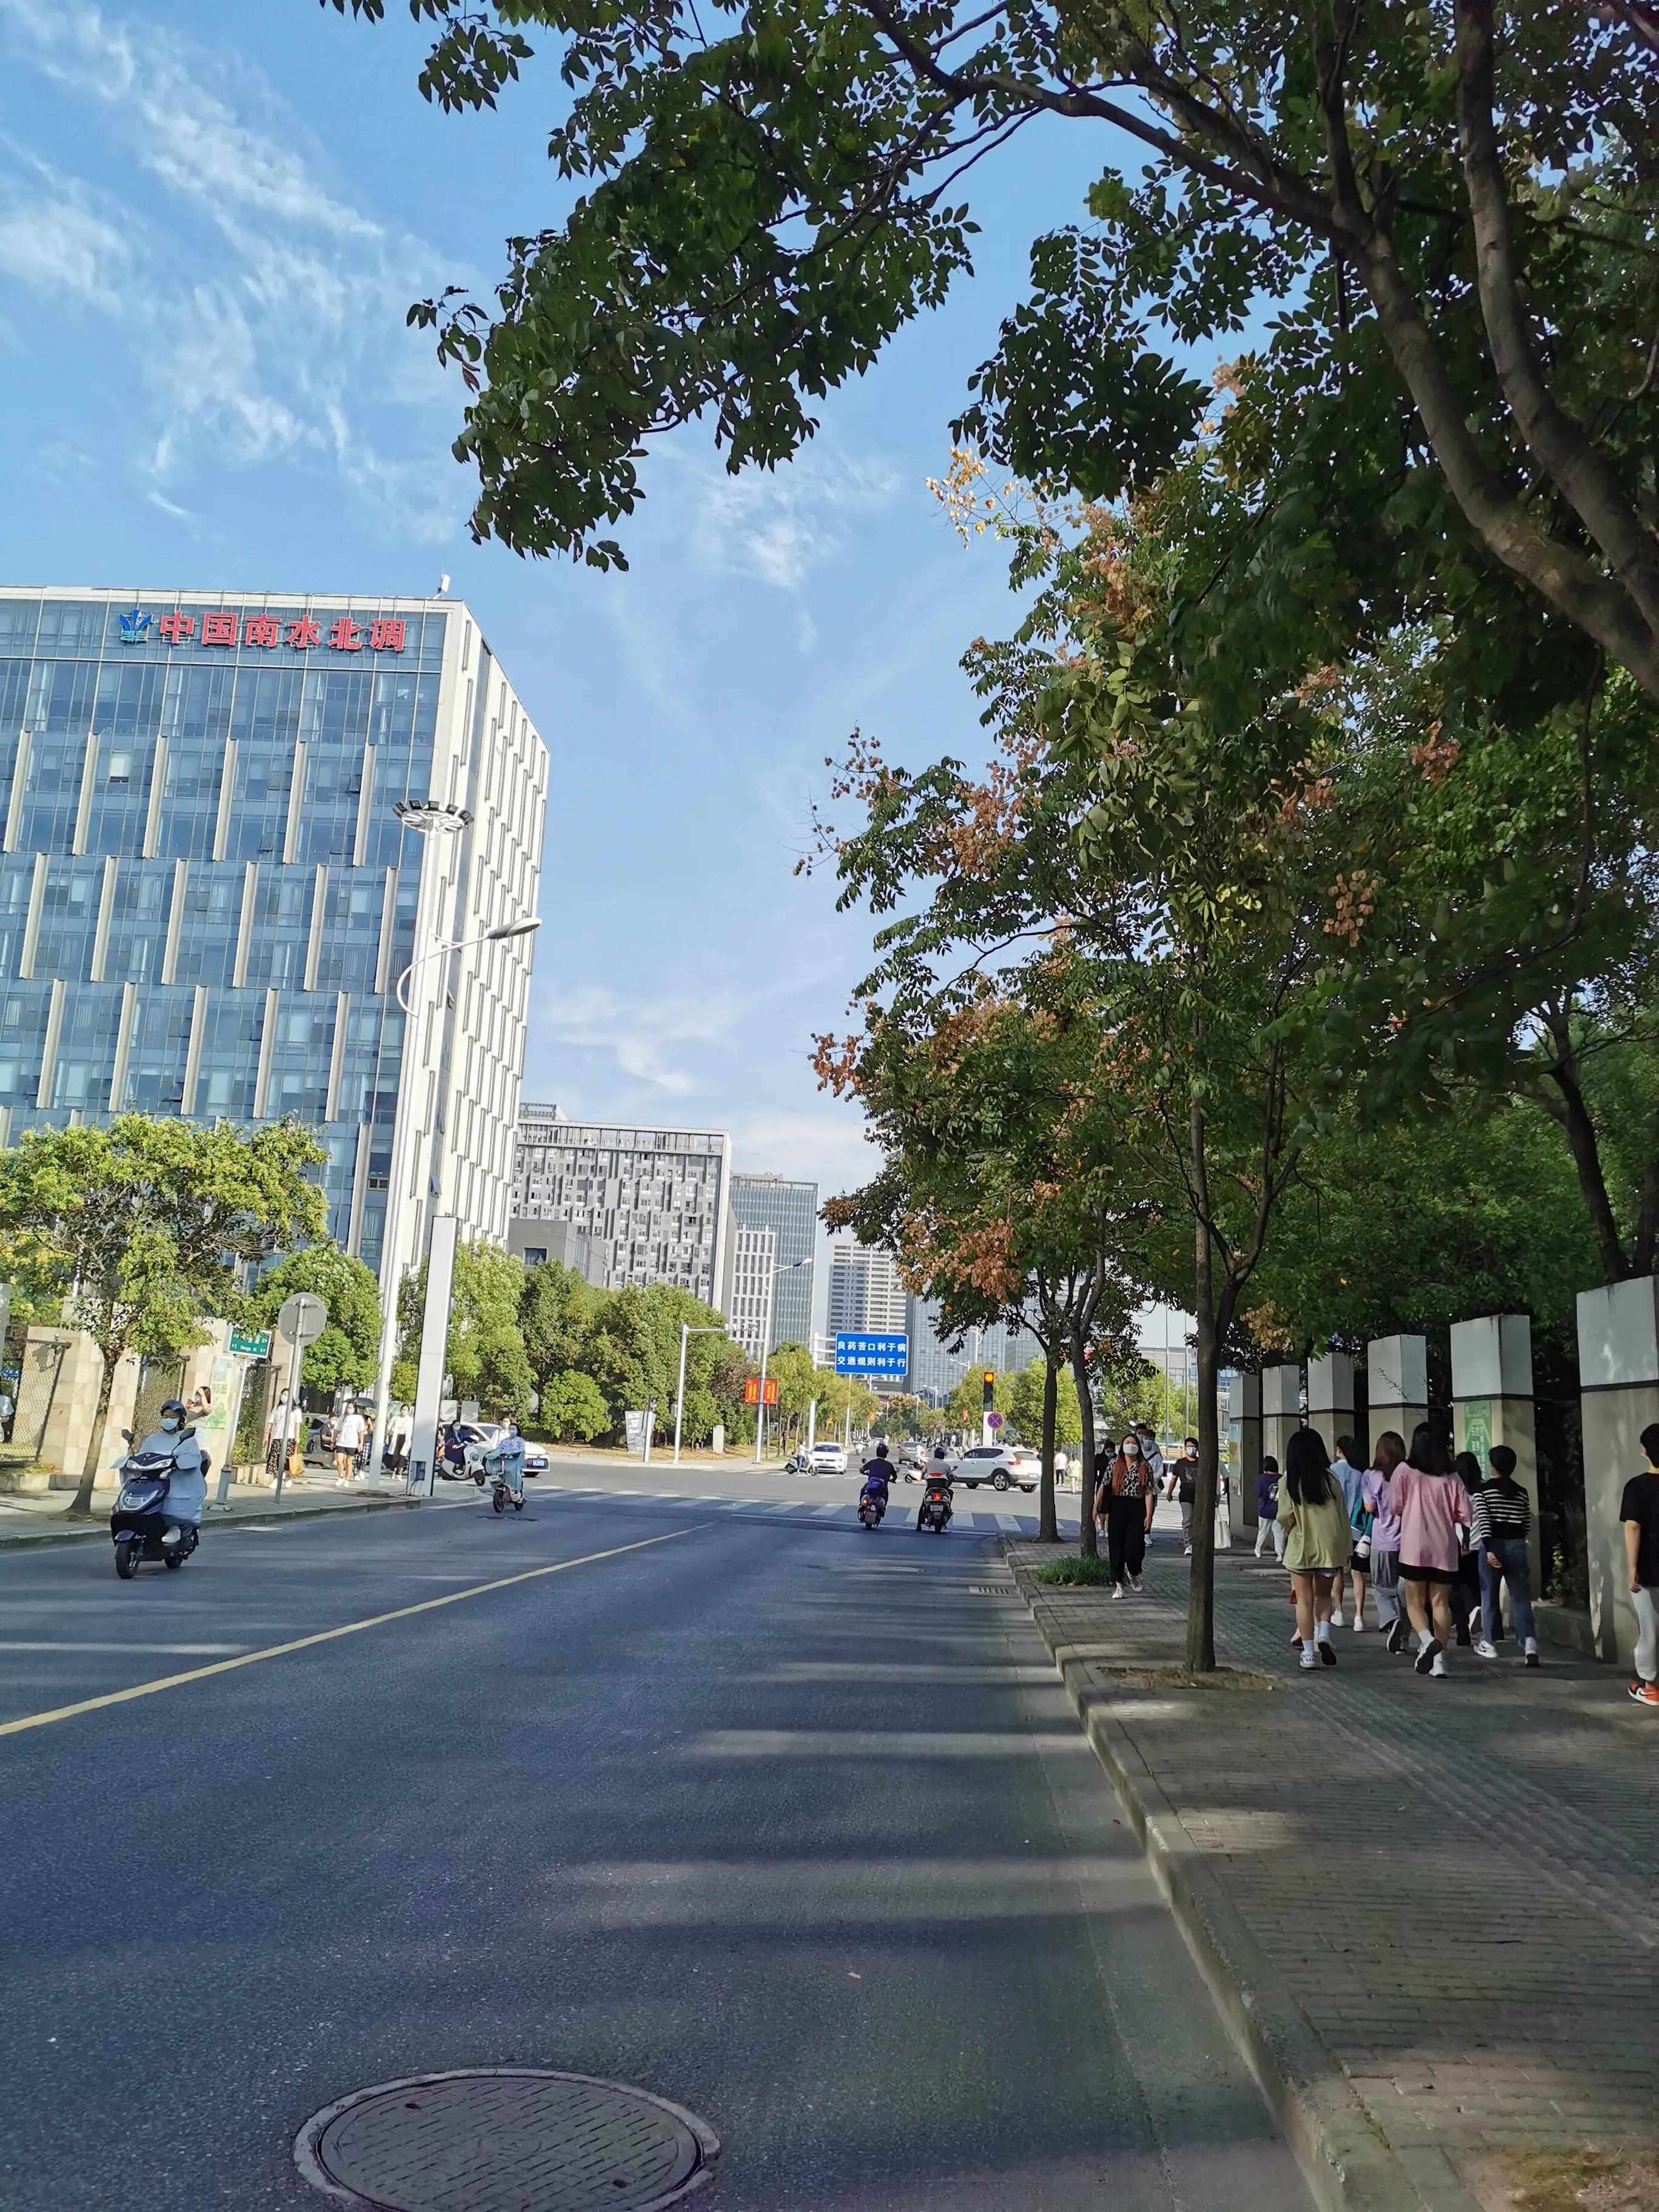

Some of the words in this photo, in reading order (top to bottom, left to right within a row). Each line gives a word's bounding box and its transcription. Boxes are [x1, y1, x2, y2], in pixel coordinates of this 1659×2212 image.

[161, 611, 406, 652] 中国南水北调
[837, 1341, 907, 1352] 良药苦口利于病
[837, 1356, 907, 1367] 交通规则利于行
